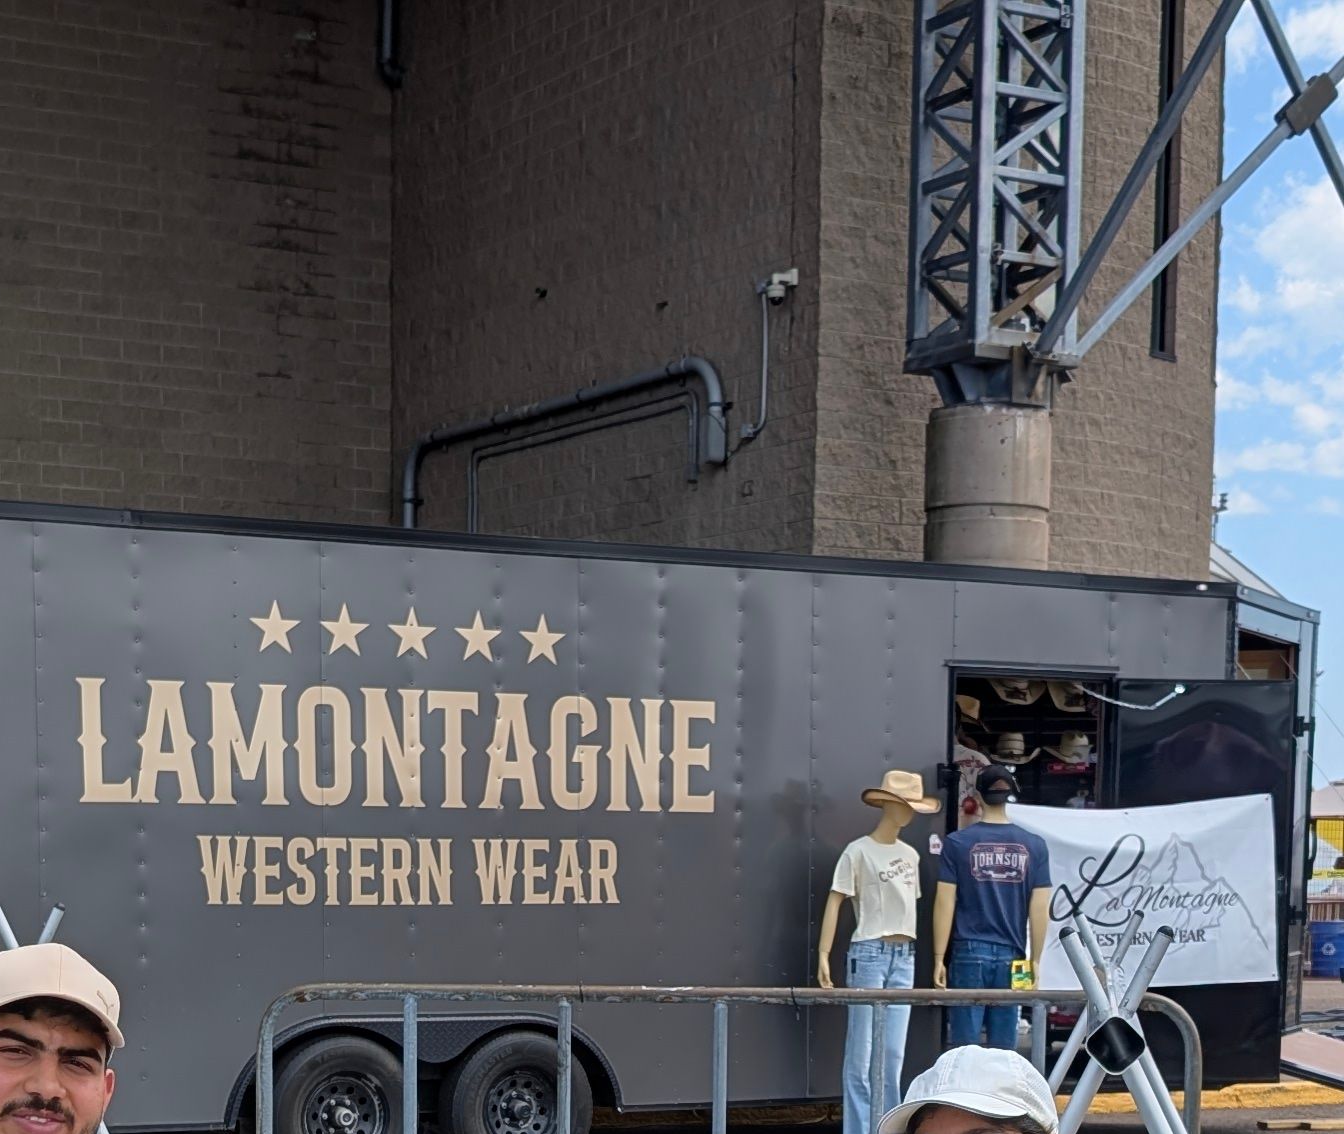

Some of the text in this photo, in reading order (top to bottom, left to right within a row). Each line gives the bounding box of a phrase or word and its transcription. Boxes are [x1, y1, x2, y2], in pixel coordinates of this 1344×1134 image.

[75, 677, 717, 813] LAMONTAGNE
[197, 835, 621, 907] WESTERN WEAR
[972, 852, 1028, 873] JOHNSON
[1121, 884, 1240, 915] Montagne
